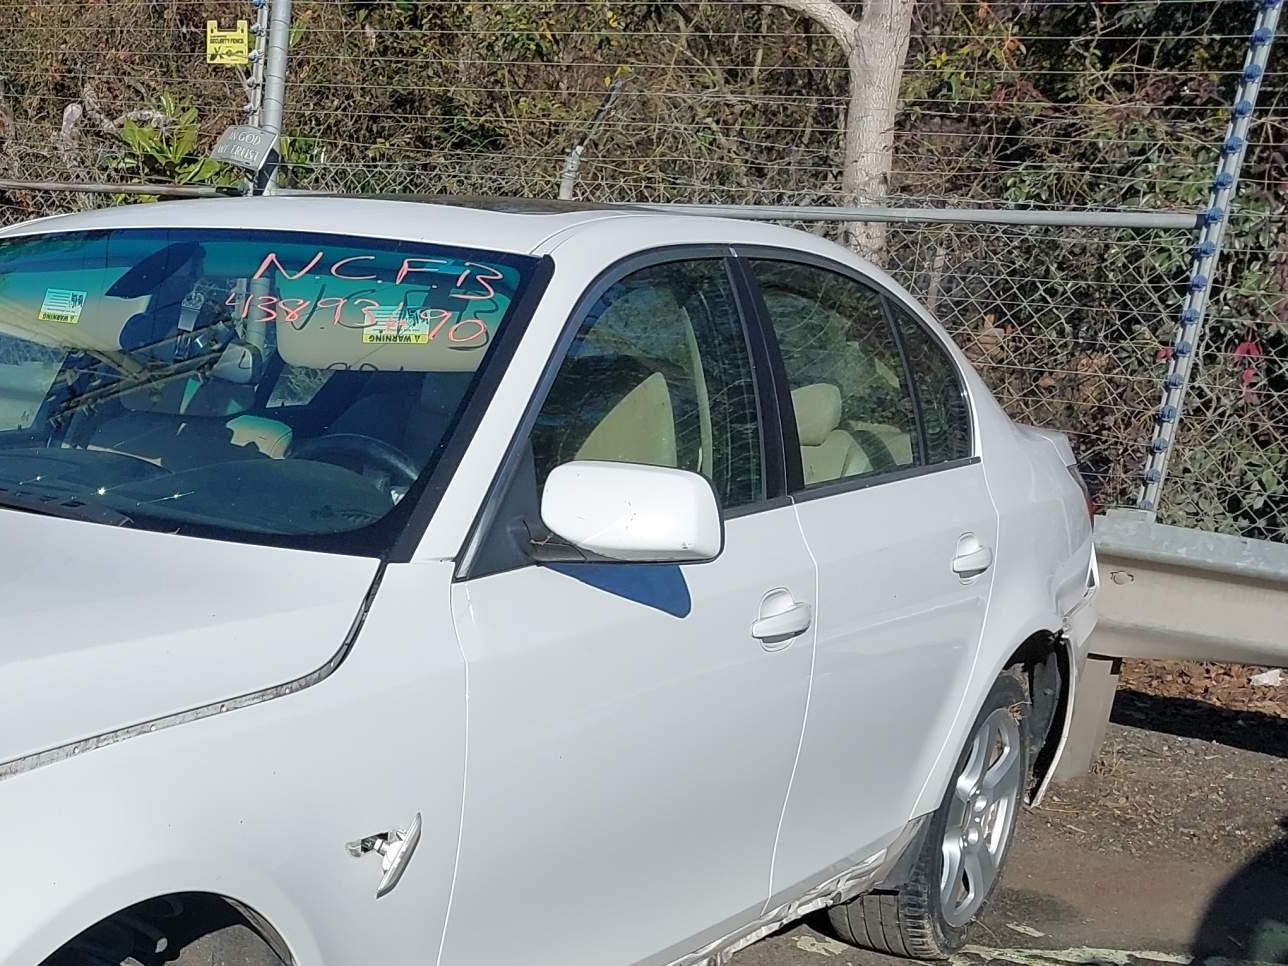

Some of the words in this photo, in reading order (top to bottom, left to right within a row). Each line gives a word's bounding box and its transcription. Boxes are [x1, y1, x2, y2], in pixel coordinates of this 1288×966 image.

[238, 131, 261, 145] GOD
[230, 144, 260, 161] TRUST
[368, 334, 412, 342] WARNING
